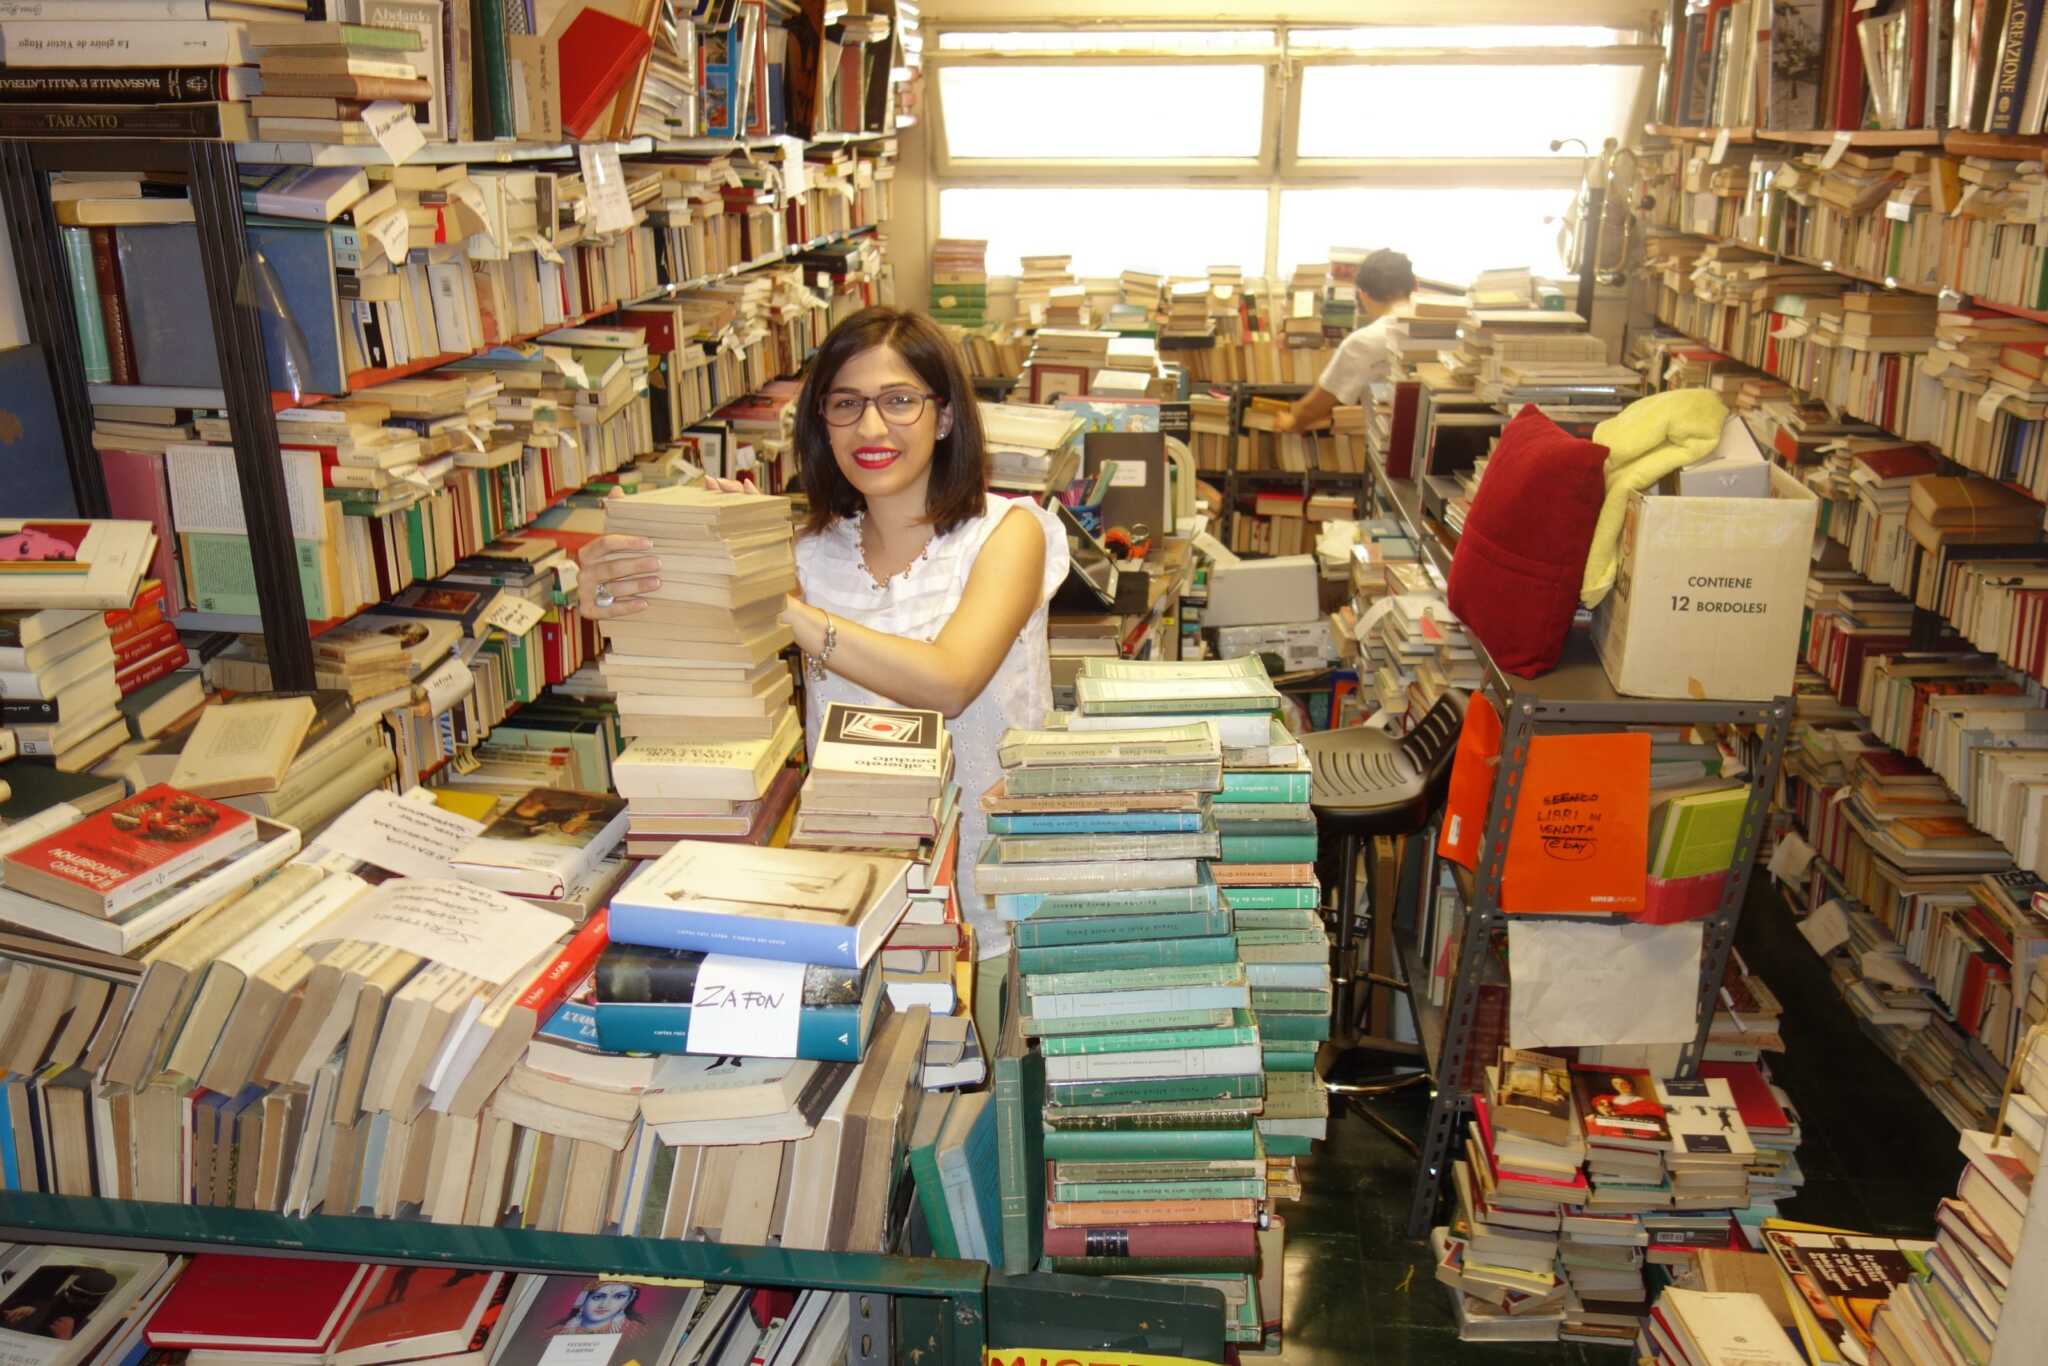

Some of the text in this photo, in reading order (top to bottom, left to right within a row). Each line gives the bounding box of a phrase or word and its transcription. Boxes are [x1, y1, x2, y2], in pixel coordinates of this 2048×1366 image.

[18, 38, 43, 49] Hugo
[46, 40, 74, 50] Victor
[1999, 10, 2027, 93] CREAZIONE
[46, 113, 118, 129] TARANTO
[1688, 575, 1752, 589] CONTIENE
[1670, 595, 1767, 614] 12 BORDOLESI
[1539, 824, 1595, 835] VENDITA
[695, 985, 784, 1010] ZAFON
